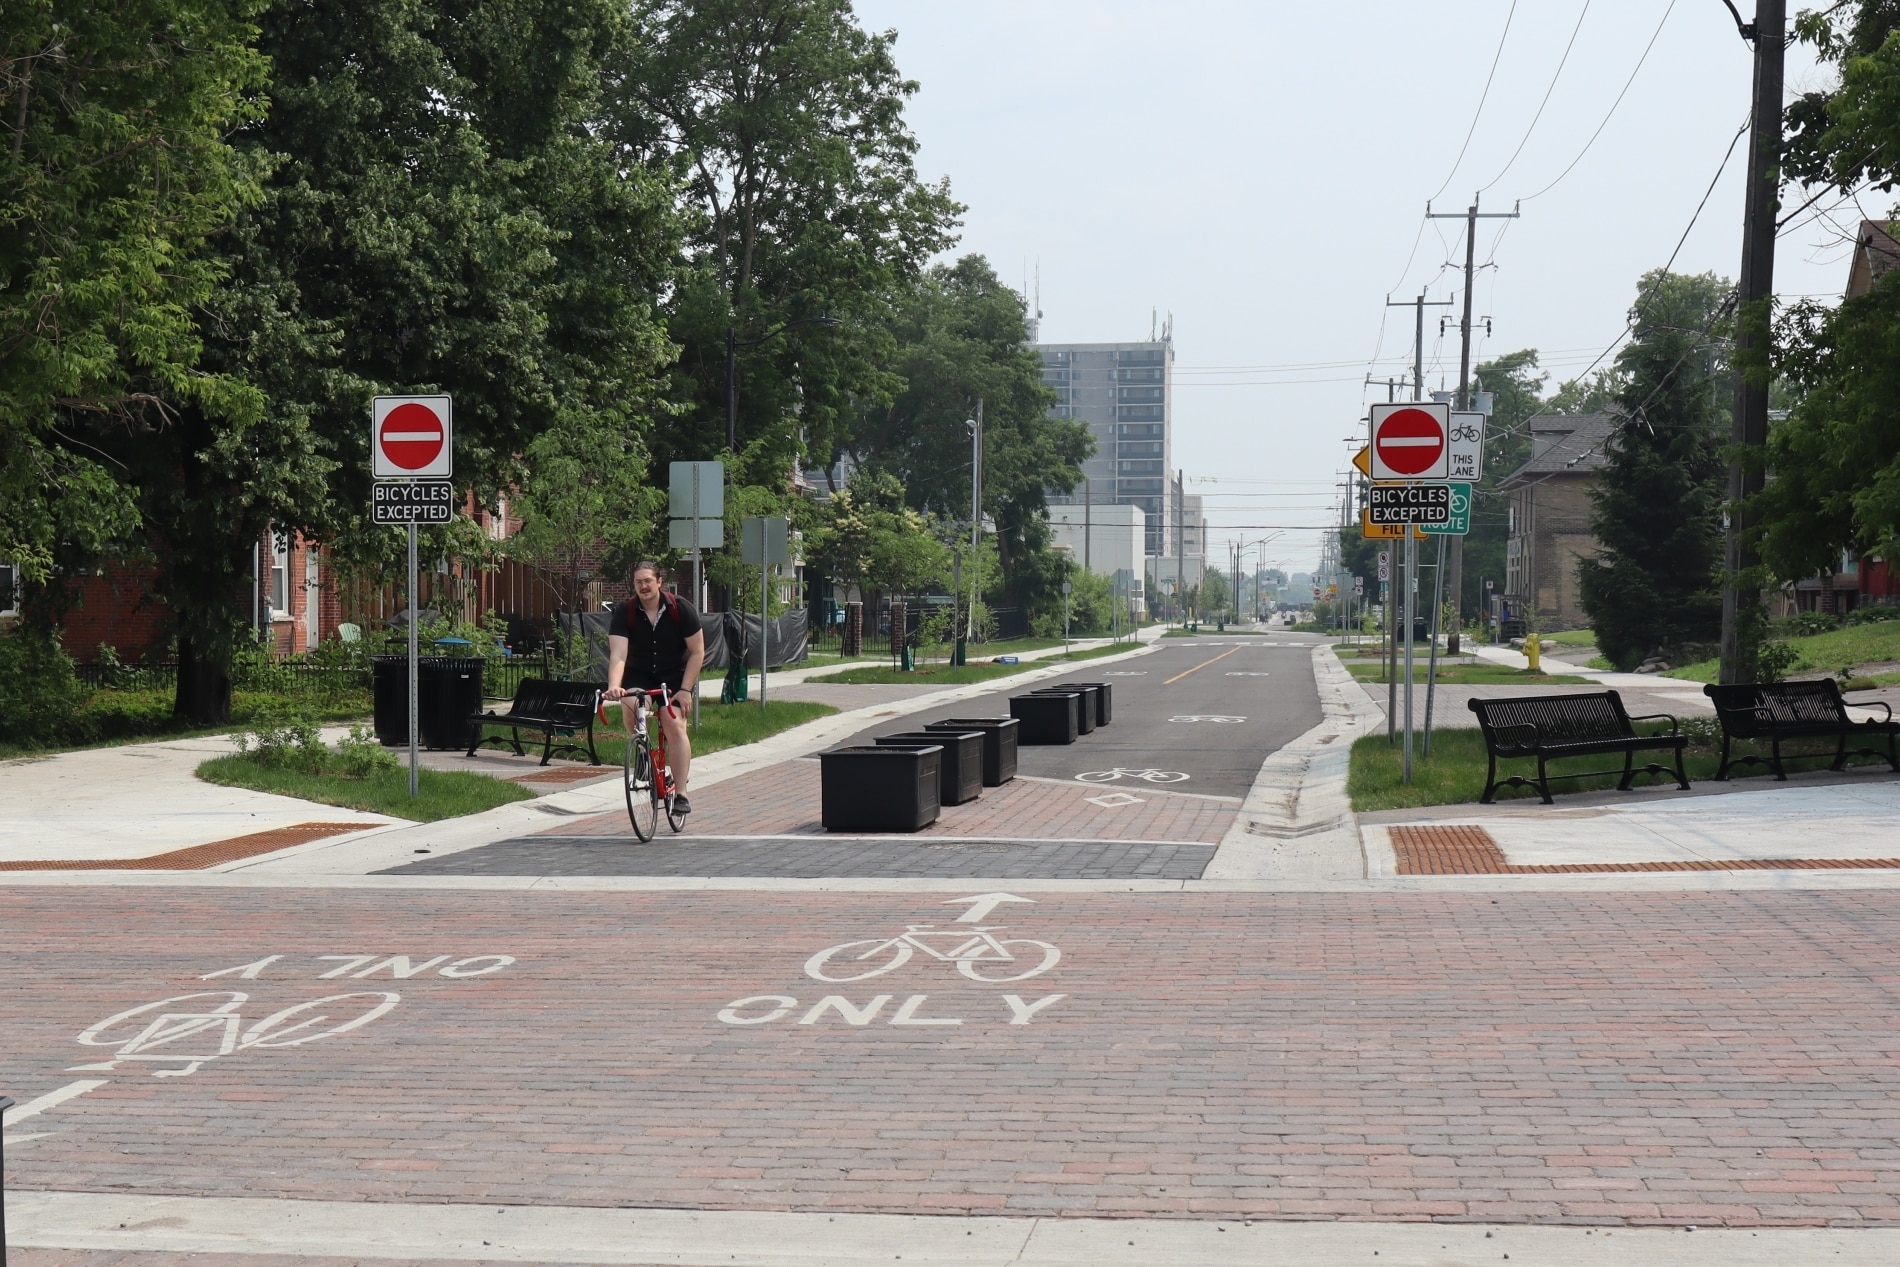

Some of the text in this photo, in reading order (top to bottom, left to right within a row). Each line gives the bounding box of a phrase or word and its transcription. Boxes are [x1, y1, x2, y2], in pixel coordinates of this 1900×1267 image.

[1453, 454, 1473, 464] THIS
[375, 486, 449, 501] BICYCLES
[1371, 489, 1447, 503] BICYCLES
[376, 505, 448, 519] EXCEPTED
[1373, 507, 1446, 521] EXCEPTED
[199, 954, 517, 979] ONLY
[716, 994, 1066, 1026] ONLY
